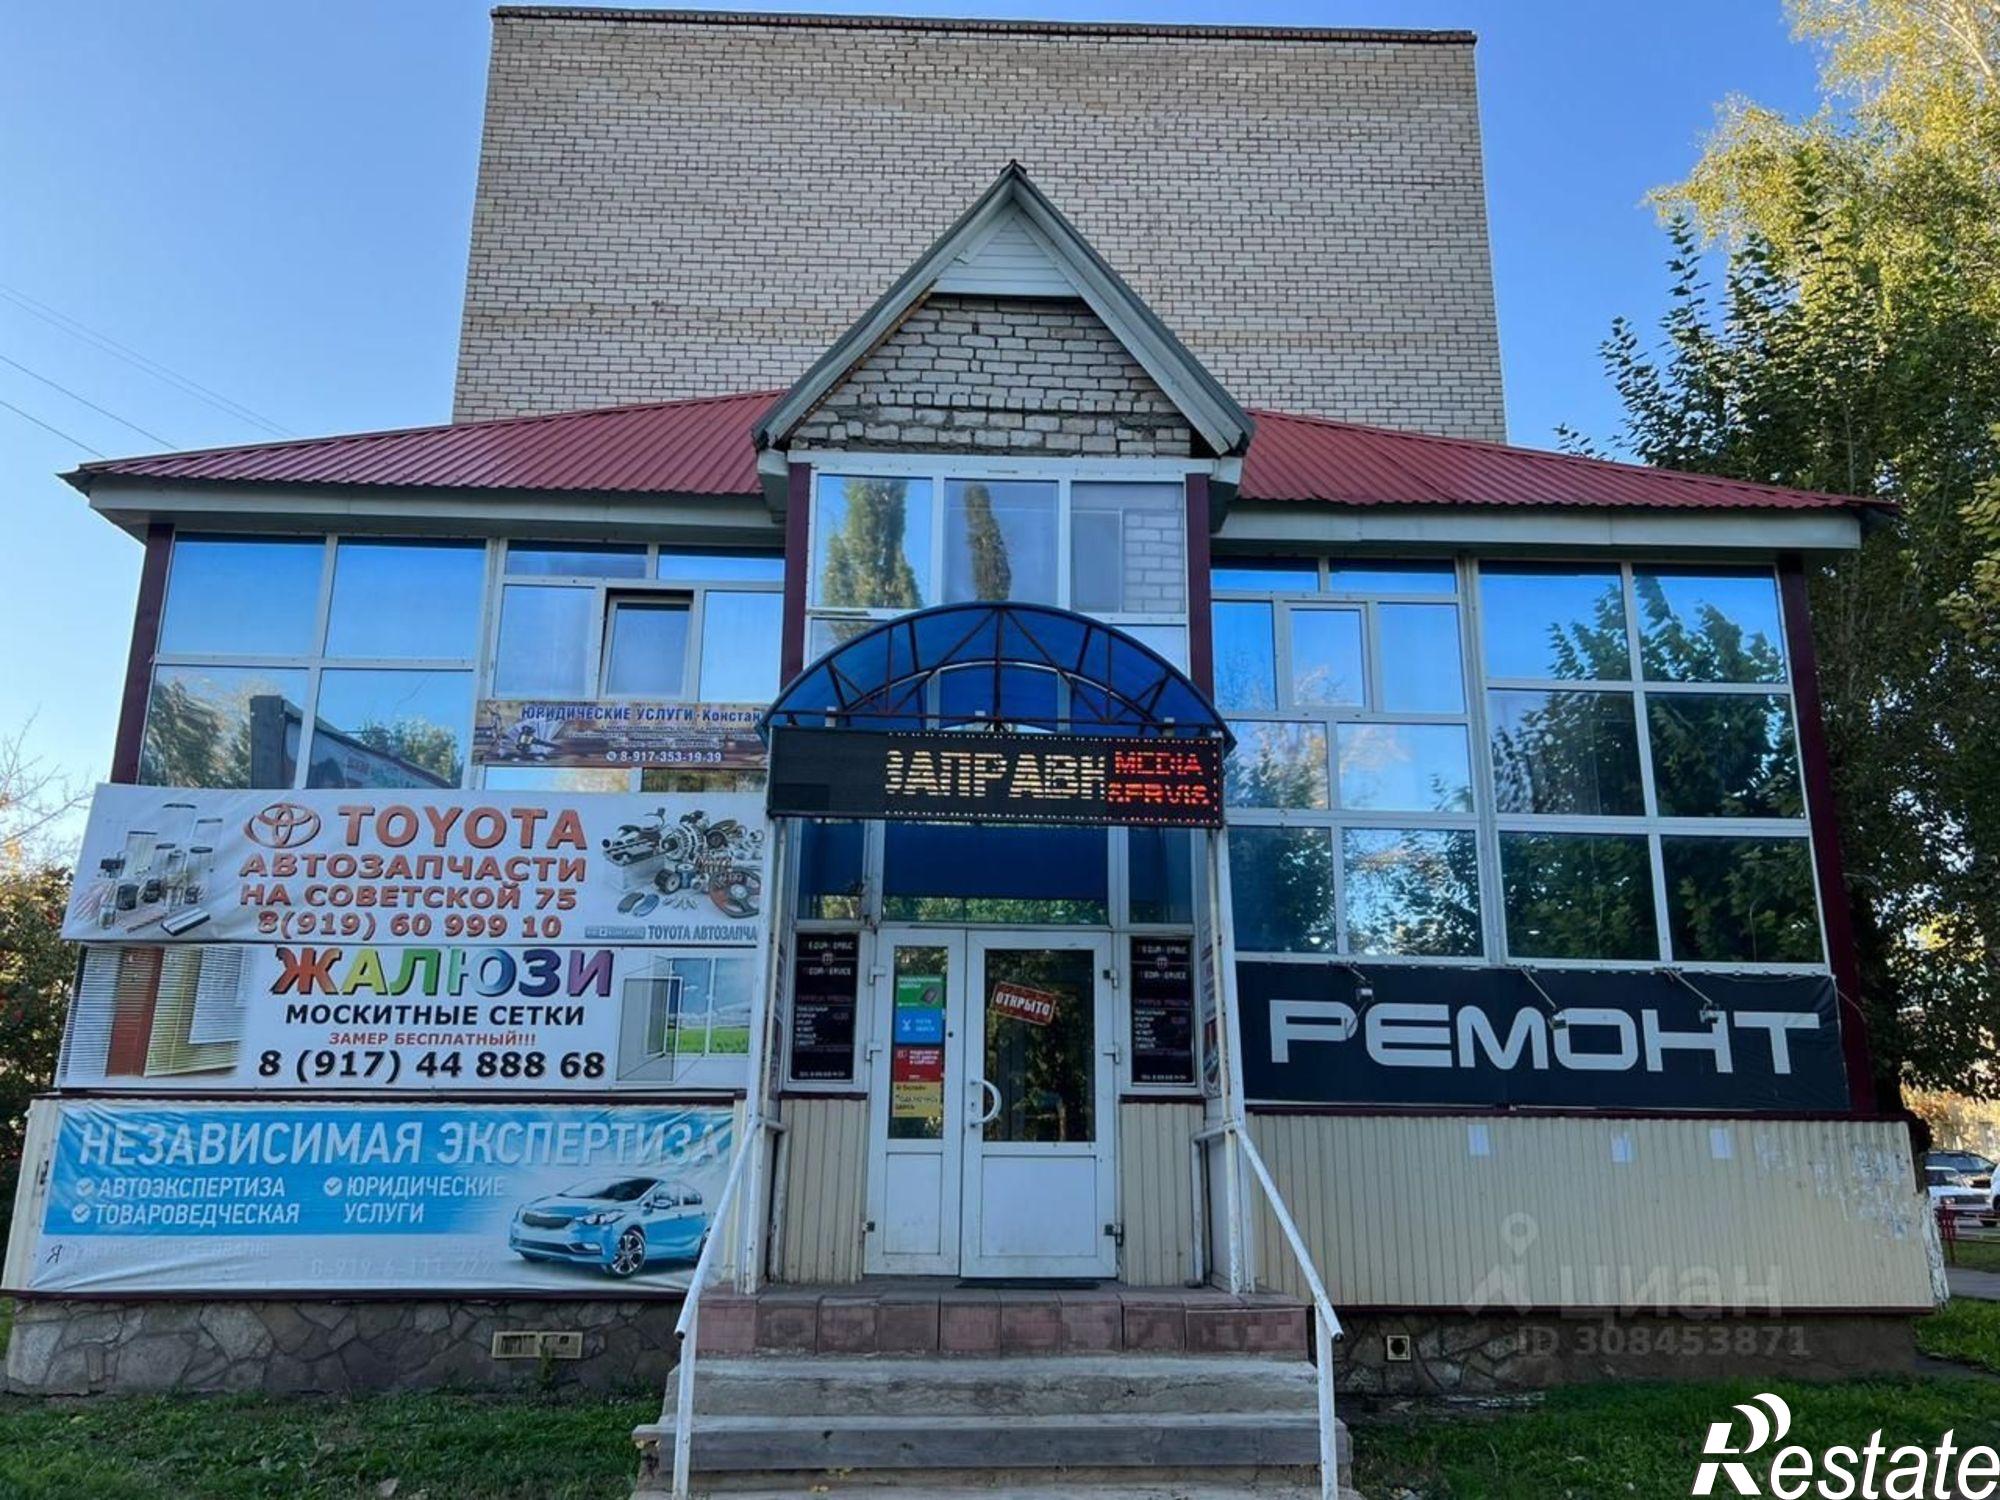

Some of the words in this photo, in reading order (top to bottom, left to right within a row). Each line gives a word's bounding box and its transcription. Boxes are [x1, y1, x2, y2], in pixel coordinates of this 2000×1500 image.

[521, 705, 631, 721] ЮРИДИЧЕСКИЕ
[636, 707, 693, 721] УСЛУГИ
[620, 751, 722, 763] 8-917-353-19-39
[1114, 751, 1203, 775] MEDIA
[337, 805, 588, 850] TOYOTA
[238, 853, 586, 881] АВТОЗАПЧАСТИ
[239, 884, 292, 906] НА
[304, 881, 520, 909] СОВЕТСКОЙ
[535, 888, 577, 909] 75
[257, 910, 377, 941] 8(919)
[390, 912, 433, 937] 60
[444, 913, 509, 938] 999
[521, 914, 562, 938] 10
[648, 925, 690, 940] TOYOTA
[271, 948, 614, 997] ЖАЛЮЗИ
[285, 1004, 478, 1026] МОСКИТНЫЕ
[488, 1005, 585, 1026] СЕТКИ
[995, 991, 1051, 1017] ОТКРЫТО
[329, 1032, 388, 1046] ЗАМЕР
[394, 1029, 537, 1047] БЕСПЛАТНЫЙ!!!
[1269, 999, 1820, 1076] РЕМОНТ
[258, 1050, 281, 1077] 8
[296, 1050, 401, 1083] (917)
[416, 1051, 463, 1078] 44
[475, 1052, 547, 1079] 888
[559, 1053, 605, 1079] 68
[78, 1121, 422, 1165] НЕЗАВИСИМАЯ
[436, 1121, 722, 1166] ЭКСПЕРТИЗА
[99, 1176, 285, 1199] АВТОЭКСПЕРТИЗА
[346, 1177, 505, 1199] ЮРИДИЧЕСКИЕ
[95, 1203, 300, 1226] ТОВАРОВЕДЧЕСКАЯ
[343, 1203, 424, 1224] УСЛУГИ
